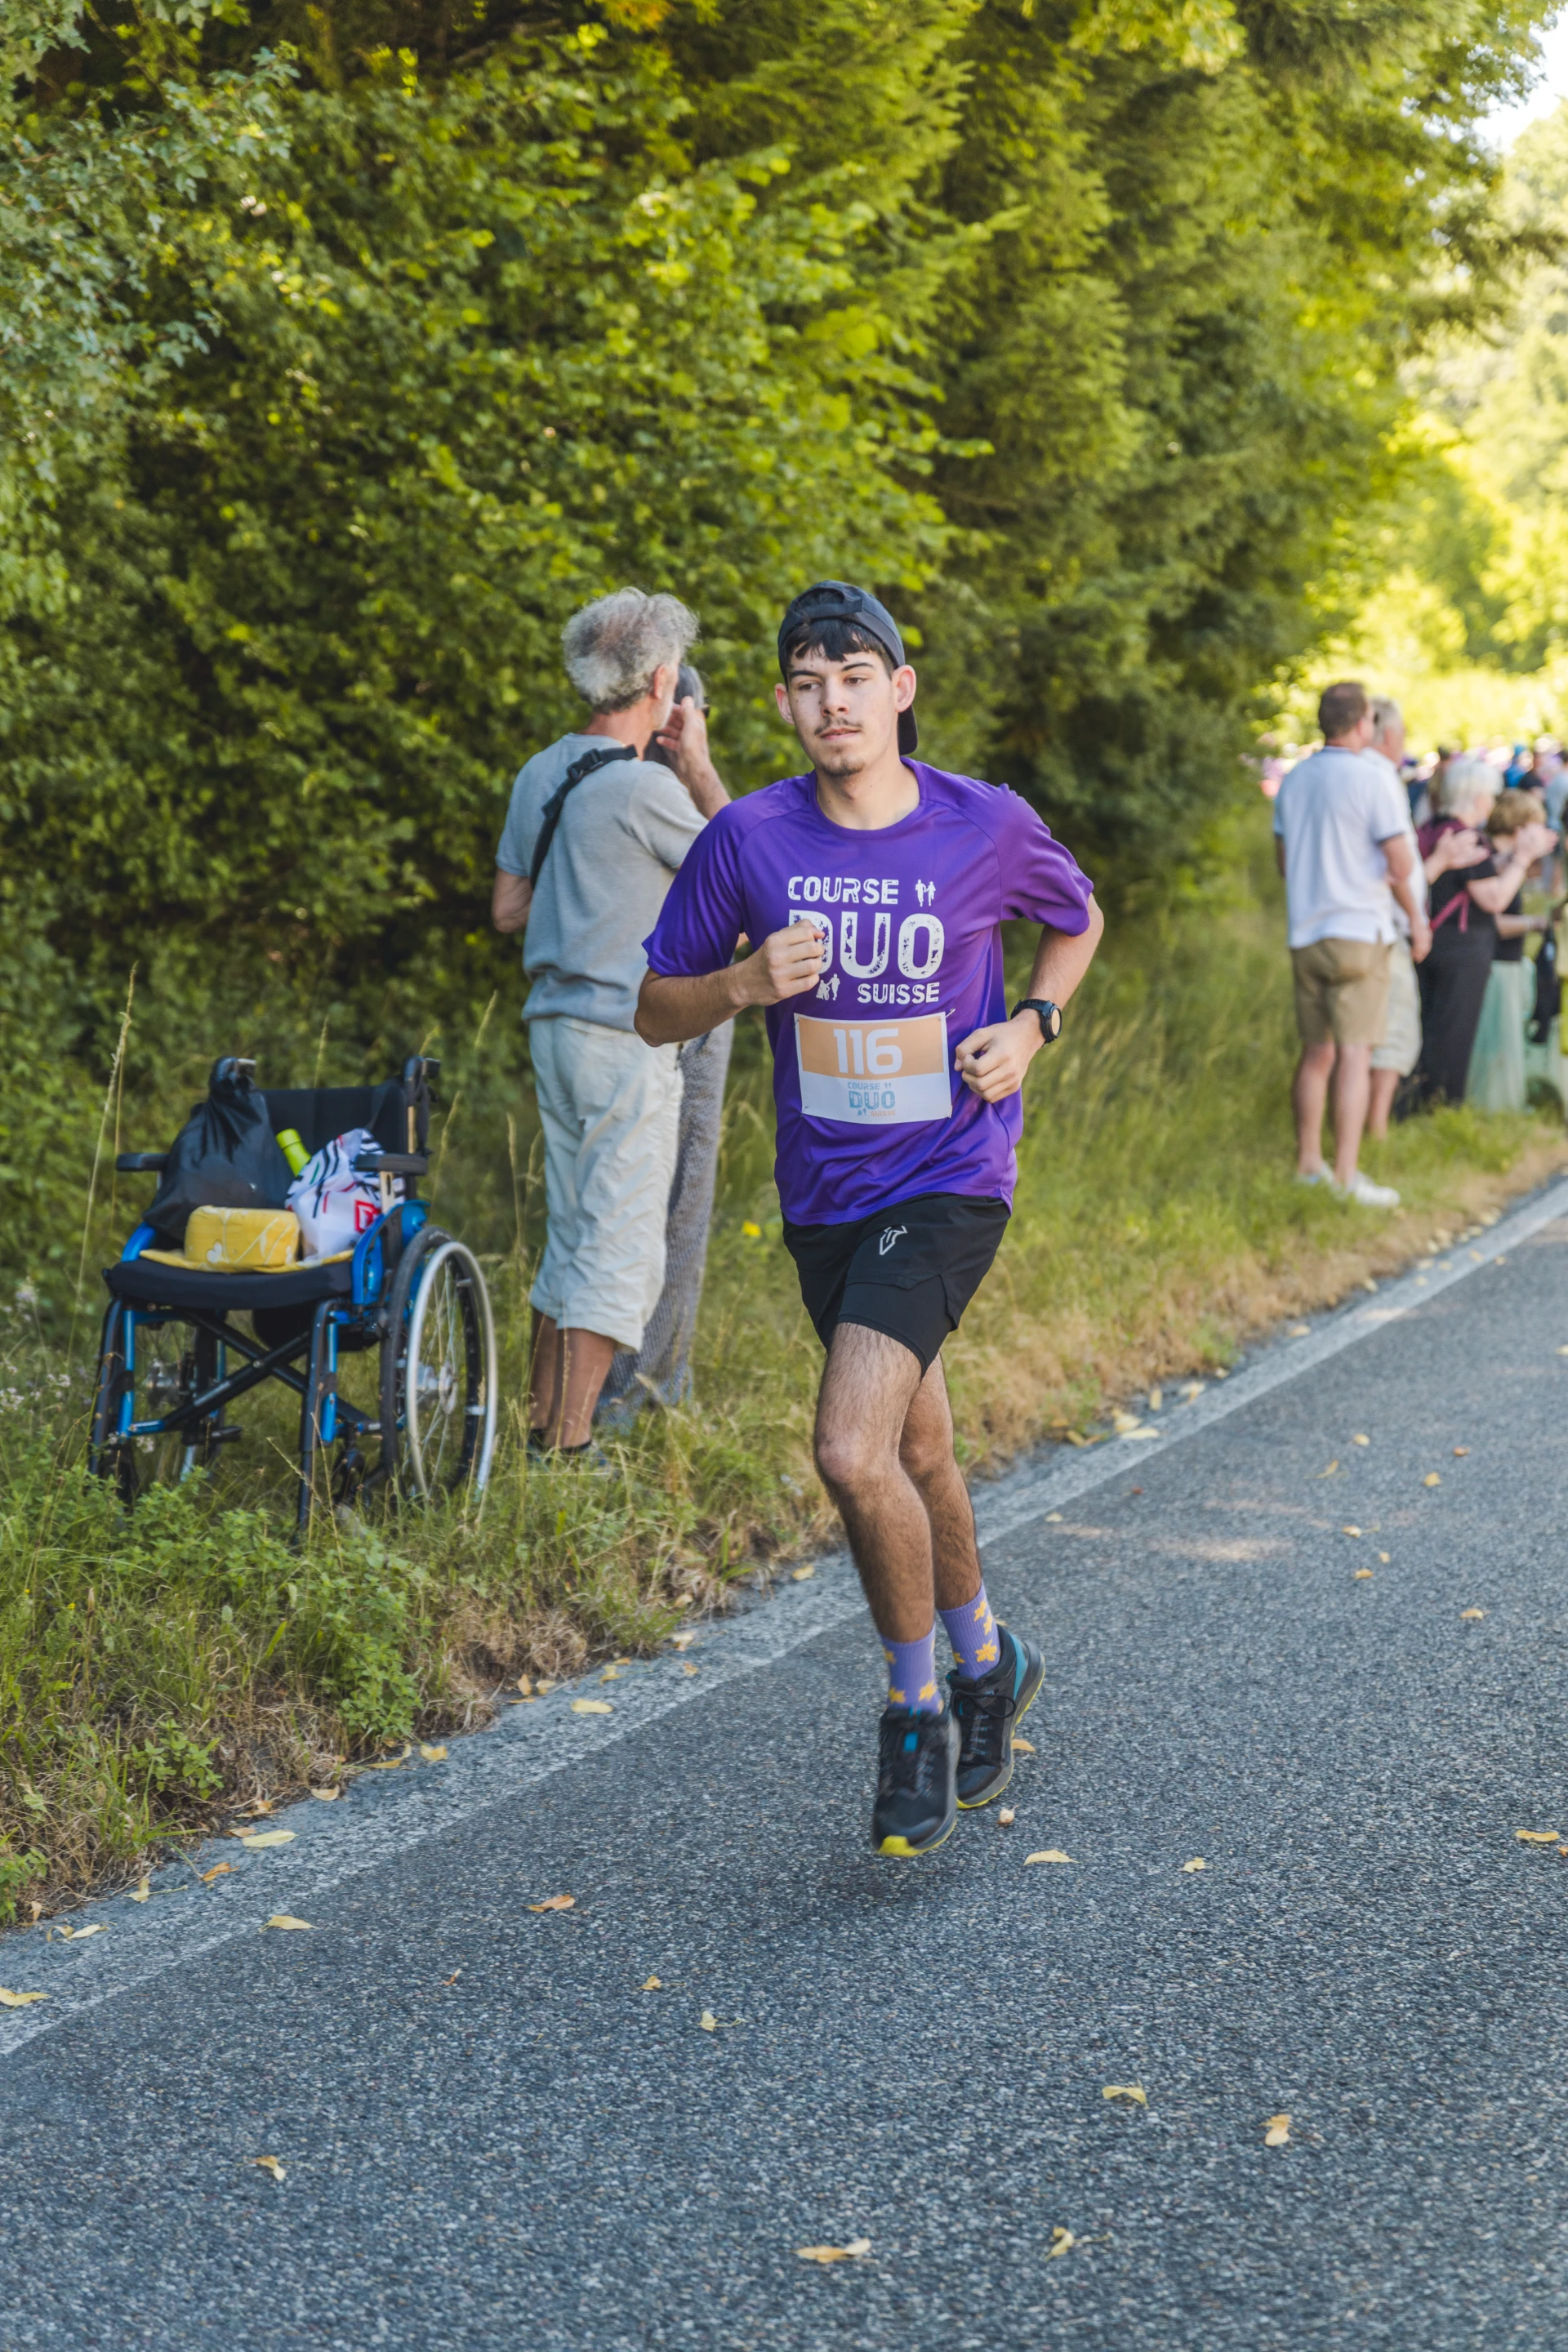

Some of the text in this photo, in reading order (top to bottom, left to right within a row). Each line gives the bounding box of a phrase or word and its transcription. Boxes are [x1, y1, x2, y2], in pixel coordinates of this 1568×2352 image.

[787, 875, 899, 905] COURSE
[857, 982, 940, 1004] SUISSE
[833, 1028, 902, 1075] 116
[847, 1081, 880, 1090] COURSE
[849, 1090, 896, 1110] DUO
